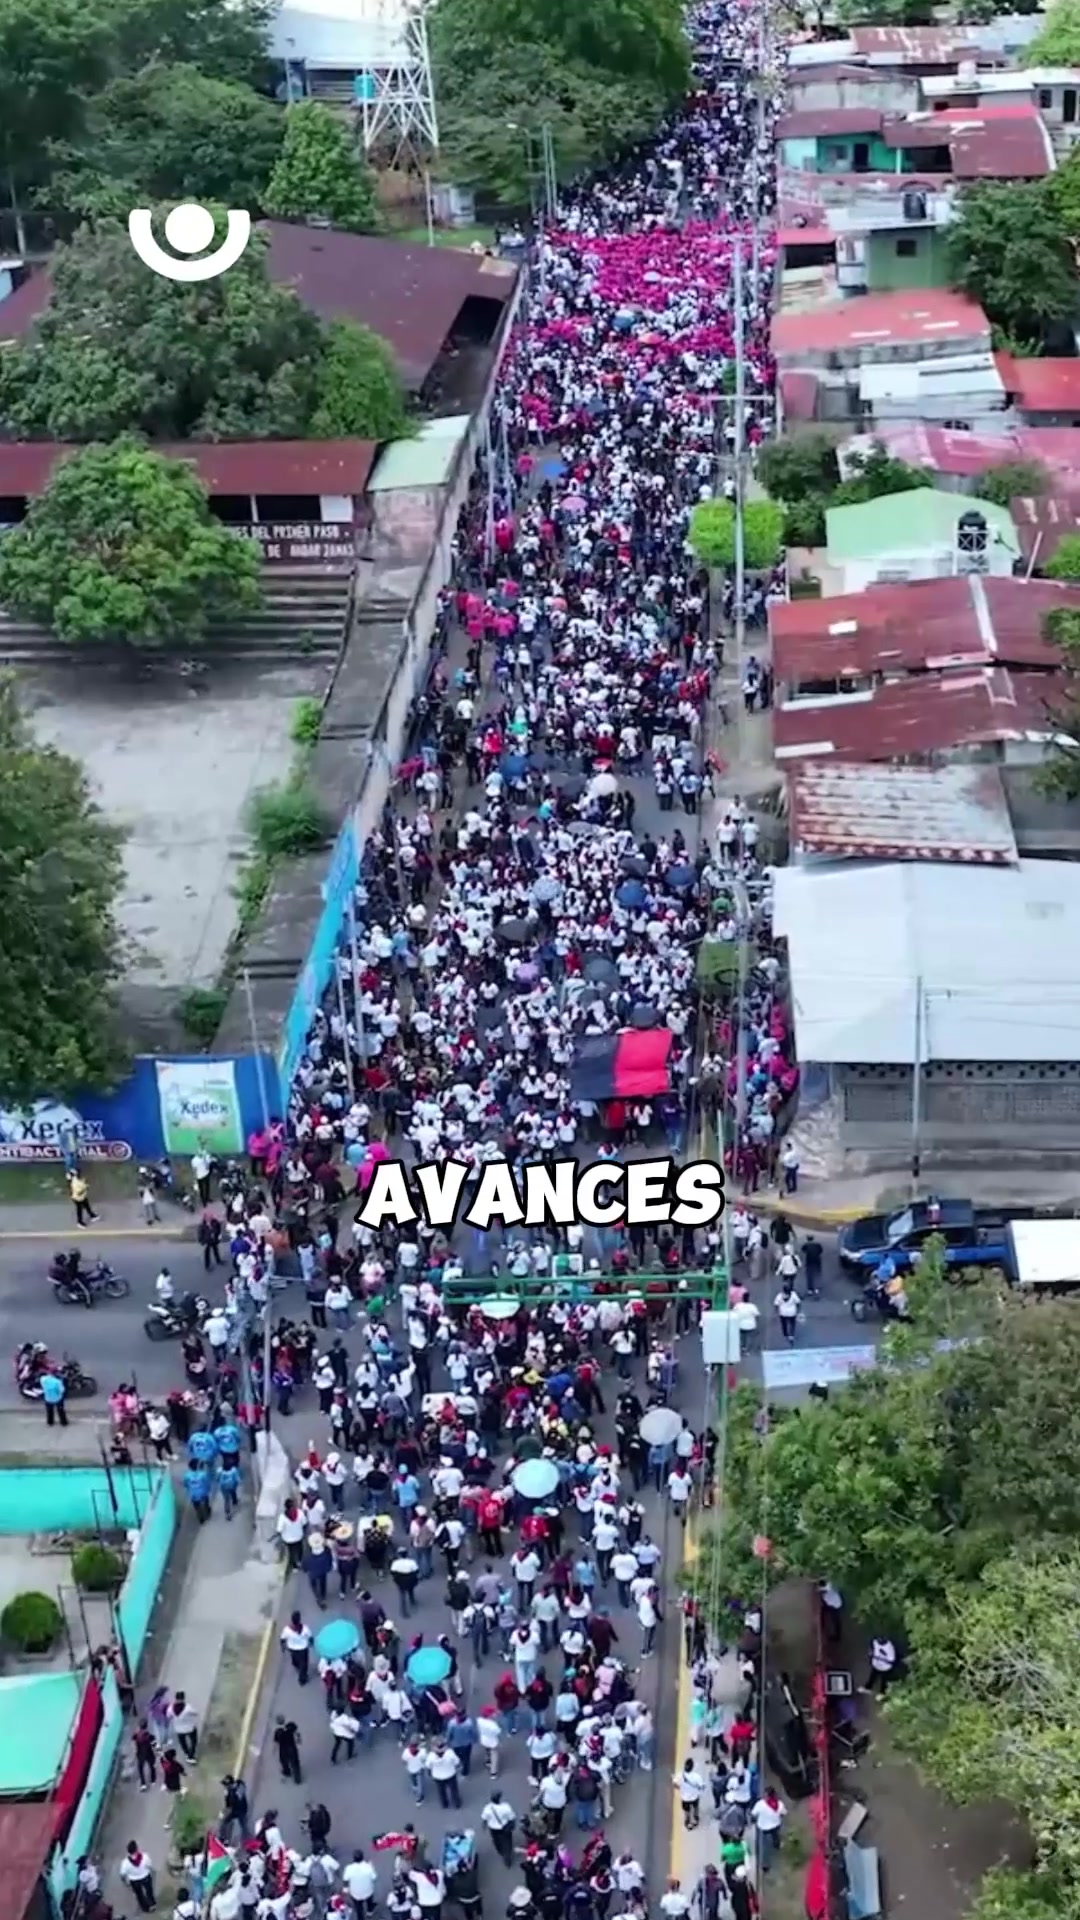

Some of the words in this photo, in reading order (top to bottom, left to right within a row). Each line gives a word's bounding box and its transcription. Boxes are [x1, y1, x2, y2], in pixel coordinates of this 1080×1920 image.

[313, 525, 339, 539] PASO
[180, 1101, 229, 1119] Xedex
[0, 1145, 108, 1158] NTIBACTIAL
